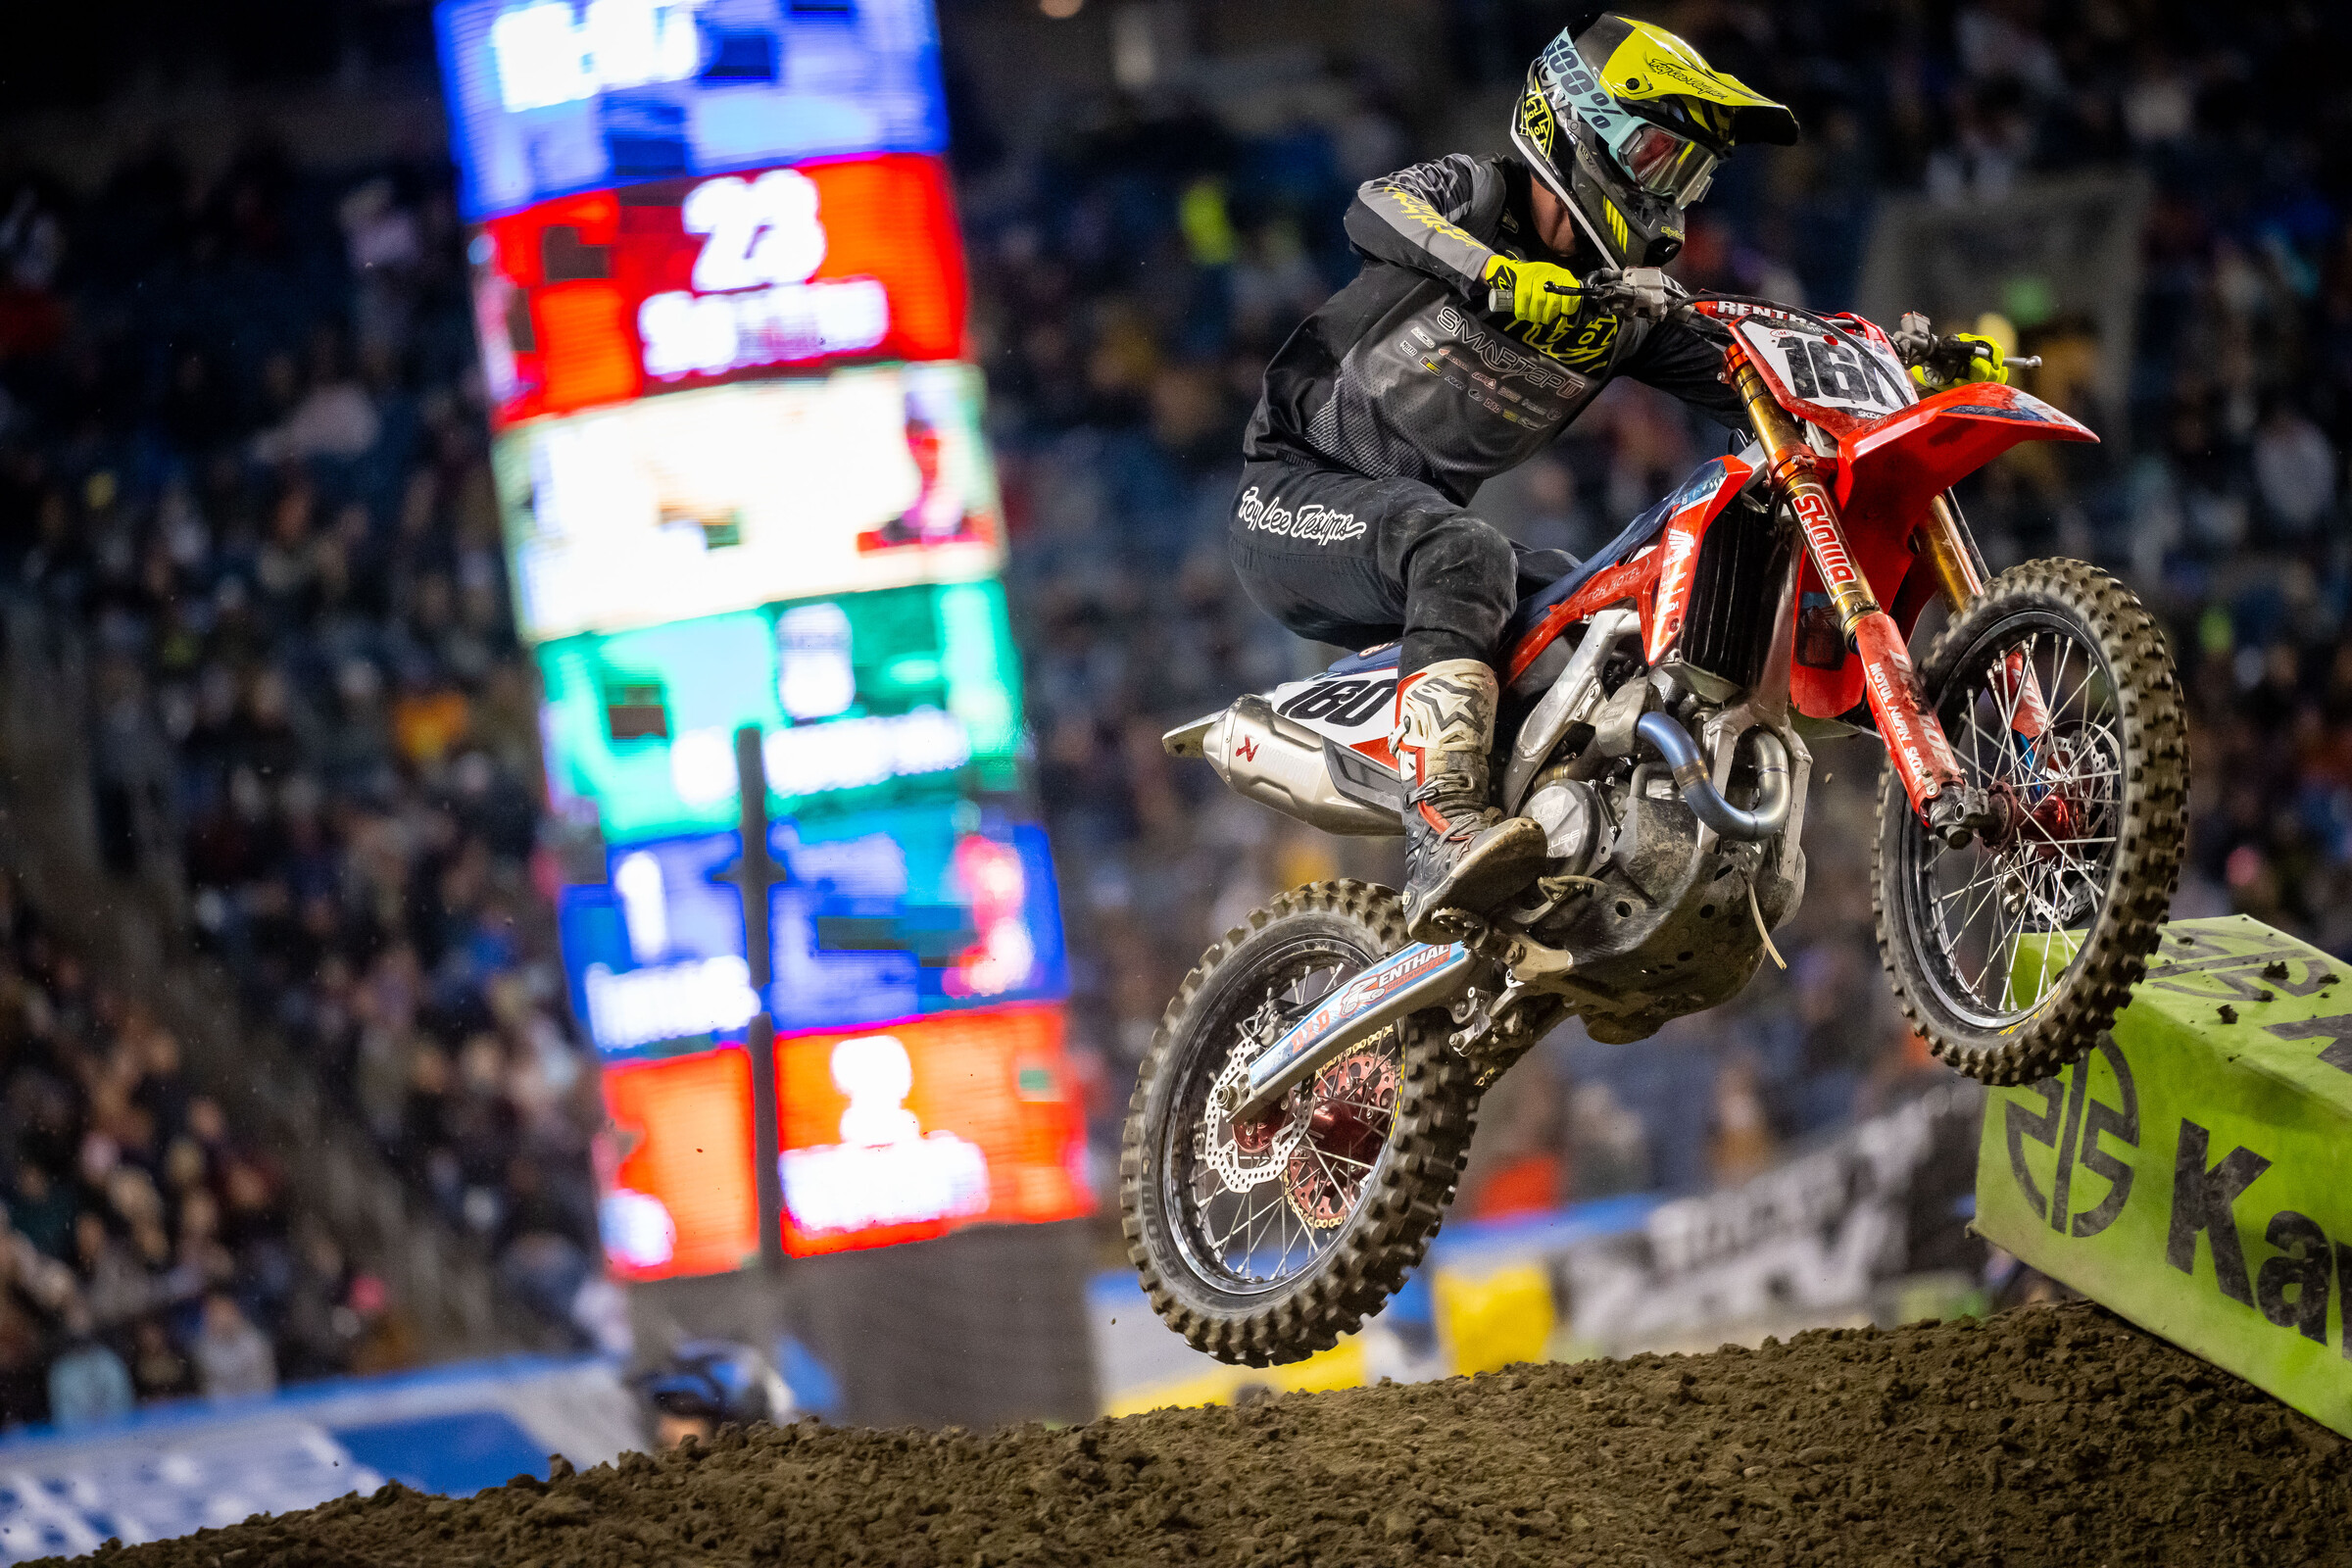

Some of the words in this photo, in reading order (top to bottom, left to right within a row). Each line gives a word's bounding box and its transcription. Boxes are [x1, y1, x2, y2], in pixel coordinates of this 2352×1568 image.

[1543, 38, 1624, 129] 100%
[1239, 486, 1263, 531] Troy
[1258, 497, 1292, 535] Lee
[1291, 505, 1367, 546] Designs
[1792, 493, 1858, 590] SHOWA
[1276, 678, 1398, 727] 160
[1868, 662, 1894, 704] MOTUL
[1387, 955, 1448, 990] CHAINWHEELS
